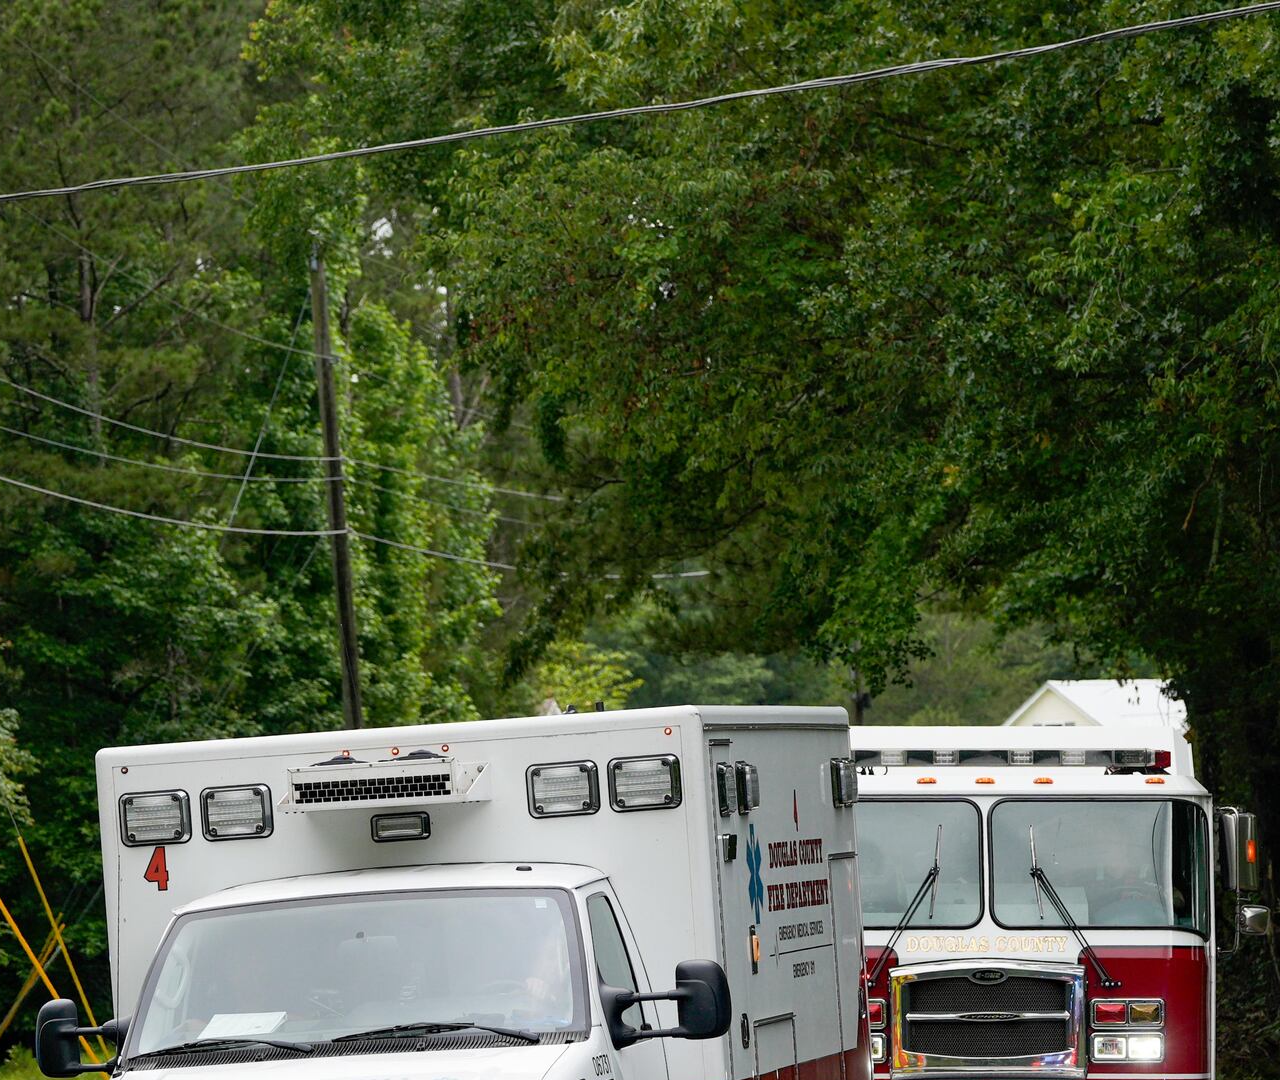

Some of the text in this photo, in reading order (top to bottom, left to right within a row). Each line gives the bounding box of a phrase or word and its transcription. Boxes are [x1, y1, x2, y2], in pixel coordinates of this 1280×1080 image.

[143, 845, 170, 892] 4
[768, 838, 823, 869] DOUGLAS COUNTY
[767, 878, 829, 912] FIRE DEPARTMENT
[906, 936, 1067, 953] DOUGLAS COUNTY
